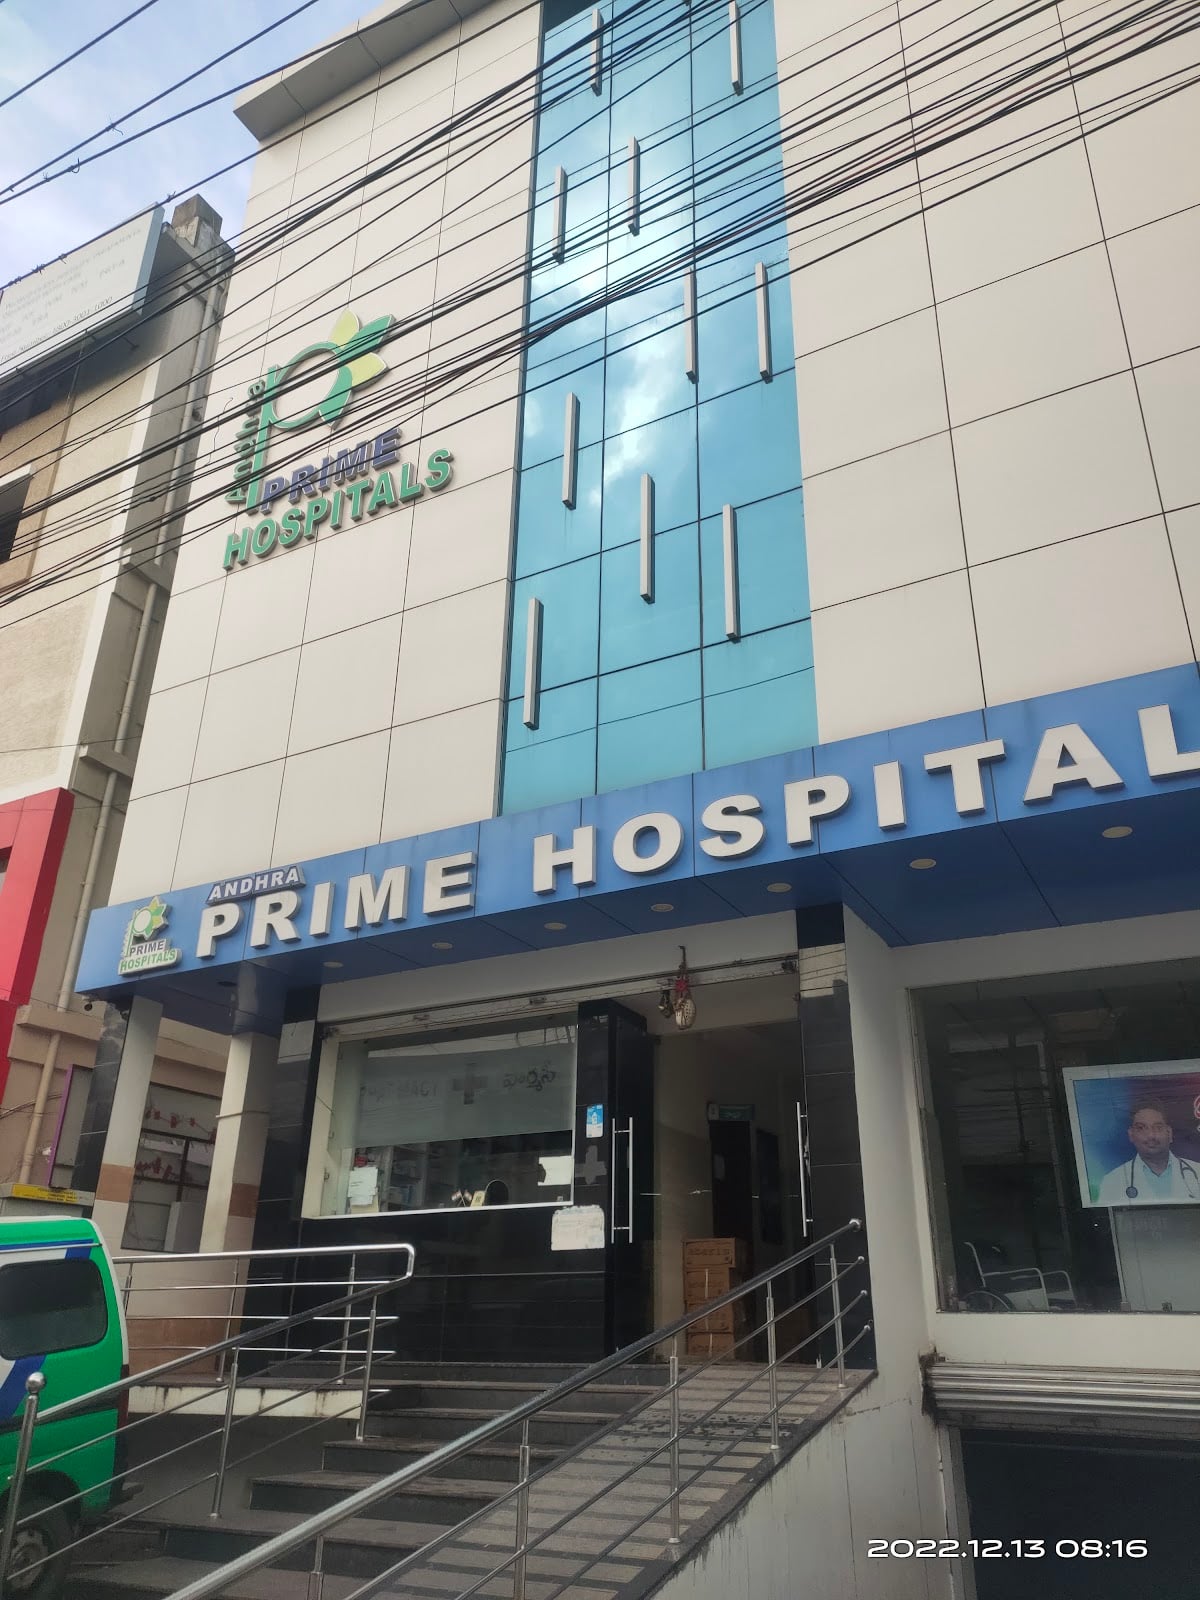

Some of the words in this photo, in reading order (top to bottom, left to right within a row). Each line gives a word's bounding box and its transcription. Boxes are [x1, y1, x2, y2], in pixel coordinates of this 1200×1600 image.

[224, 379, 265, 503] Andha
[260, 426, 401, 512] PRIME
[223, 448, 453, 570] HOSPITALS
[196, 851, 475, 959] PRIME
[532, 703, 1200, 895] HOSPITAL
[207, 867, 300, 902] ANDHRA
[120, 949, 176, 973] HOSPITALS
[130, 940, 165, 957] PRIME
